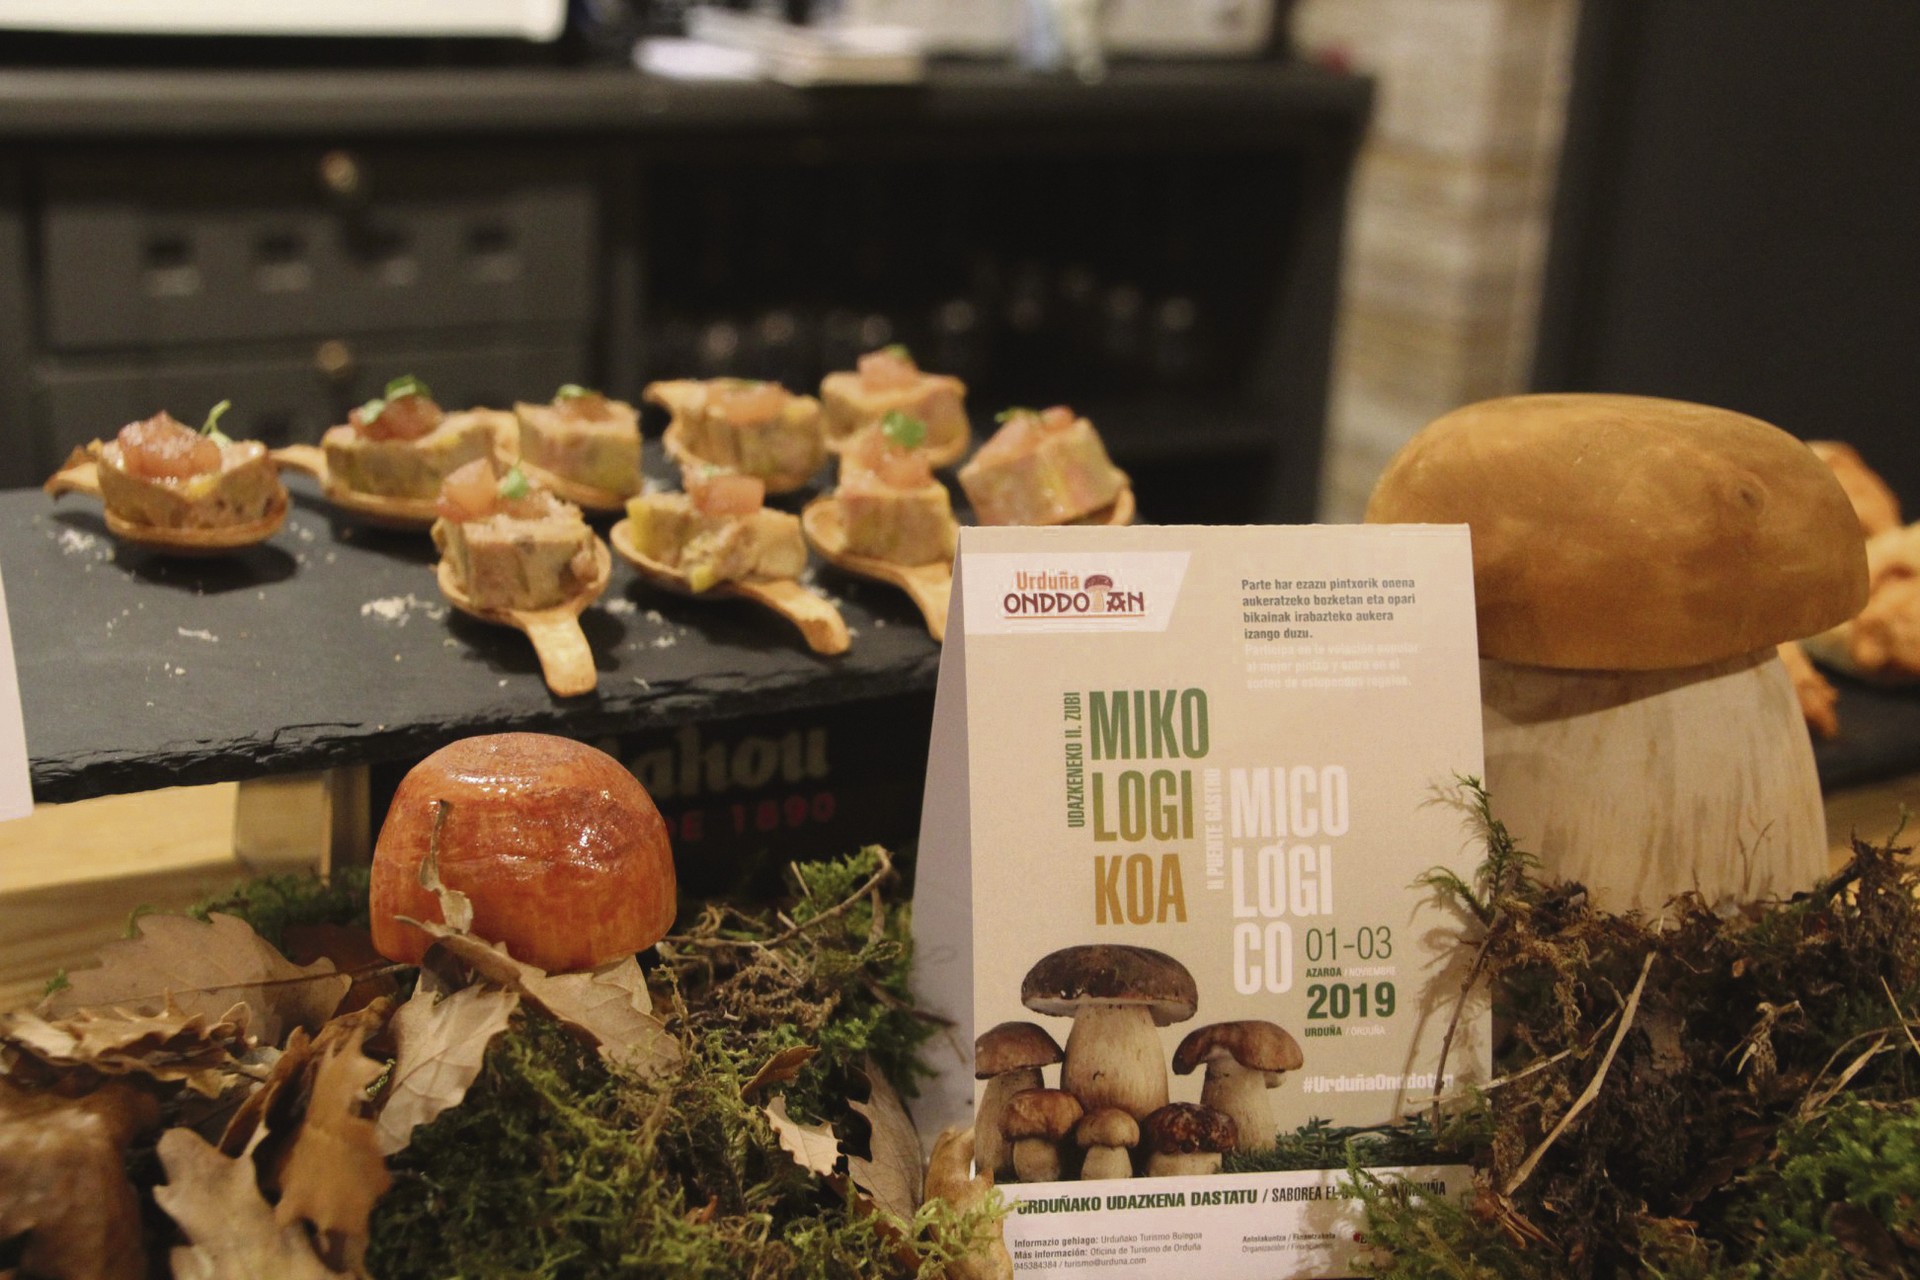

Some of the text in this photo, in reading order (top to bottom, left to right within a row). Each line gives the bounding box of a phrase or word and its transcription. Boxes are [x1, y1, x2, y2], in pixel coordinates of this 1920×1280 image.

[1016, 572, 1079, 590] Urduña
[1242, 578, 1415, 591] Parte har ezazu pintxorik onena
[1243, 593, 1415, 606] aukeratzeko bozketan eta opari
[1243, 610, 1393, 622] bikainak irabazteko aukera
[1244, 627, 1313, 641] izango duzu.
[1089, 687, 1209, 761] MIKO
[1063, 692, 1085, 828] UDAZKENEKO II. ZUBI
[1092, 769, 1194, 842] LOGI
[1204, 768, 1222, 821] GASTRO
[1229, 764, 1350, 838] MICO
[1205, 824, 1225, 877] PUENTE
[1094, 852, 1188, 926] KOA
[1231, 839, 1334, 918] LÓGI
[1233, 921, 1293, 995] CO
[1306, 926, 1393, 962] 01-03
[1306, 967, 1342, 978] AZAROA
[1350, 966, 1396, 977] NOVIEMBRE
[1306, 981, 1396, 1019] 2019
[1304, 1025, 1342, 1037] URDUÑA
[1106, 1192, 1186, 1211] UDAZKENA
[1191, 1189, 1258, 1207] DASTATU
[1272, 1185, 1322, 1203] SABOREA
[1014, 1238, 1060, 1248] Informazio
[1062, 1236, 1098, 1247] gehiago:
[1101, 1233, 1138, 1244] Urduñako
[1140, 1232, 1170, 1242] Turismo
[1014, 1242, 1202, 1260] Más información: Oficina de Turismo de Orduña
